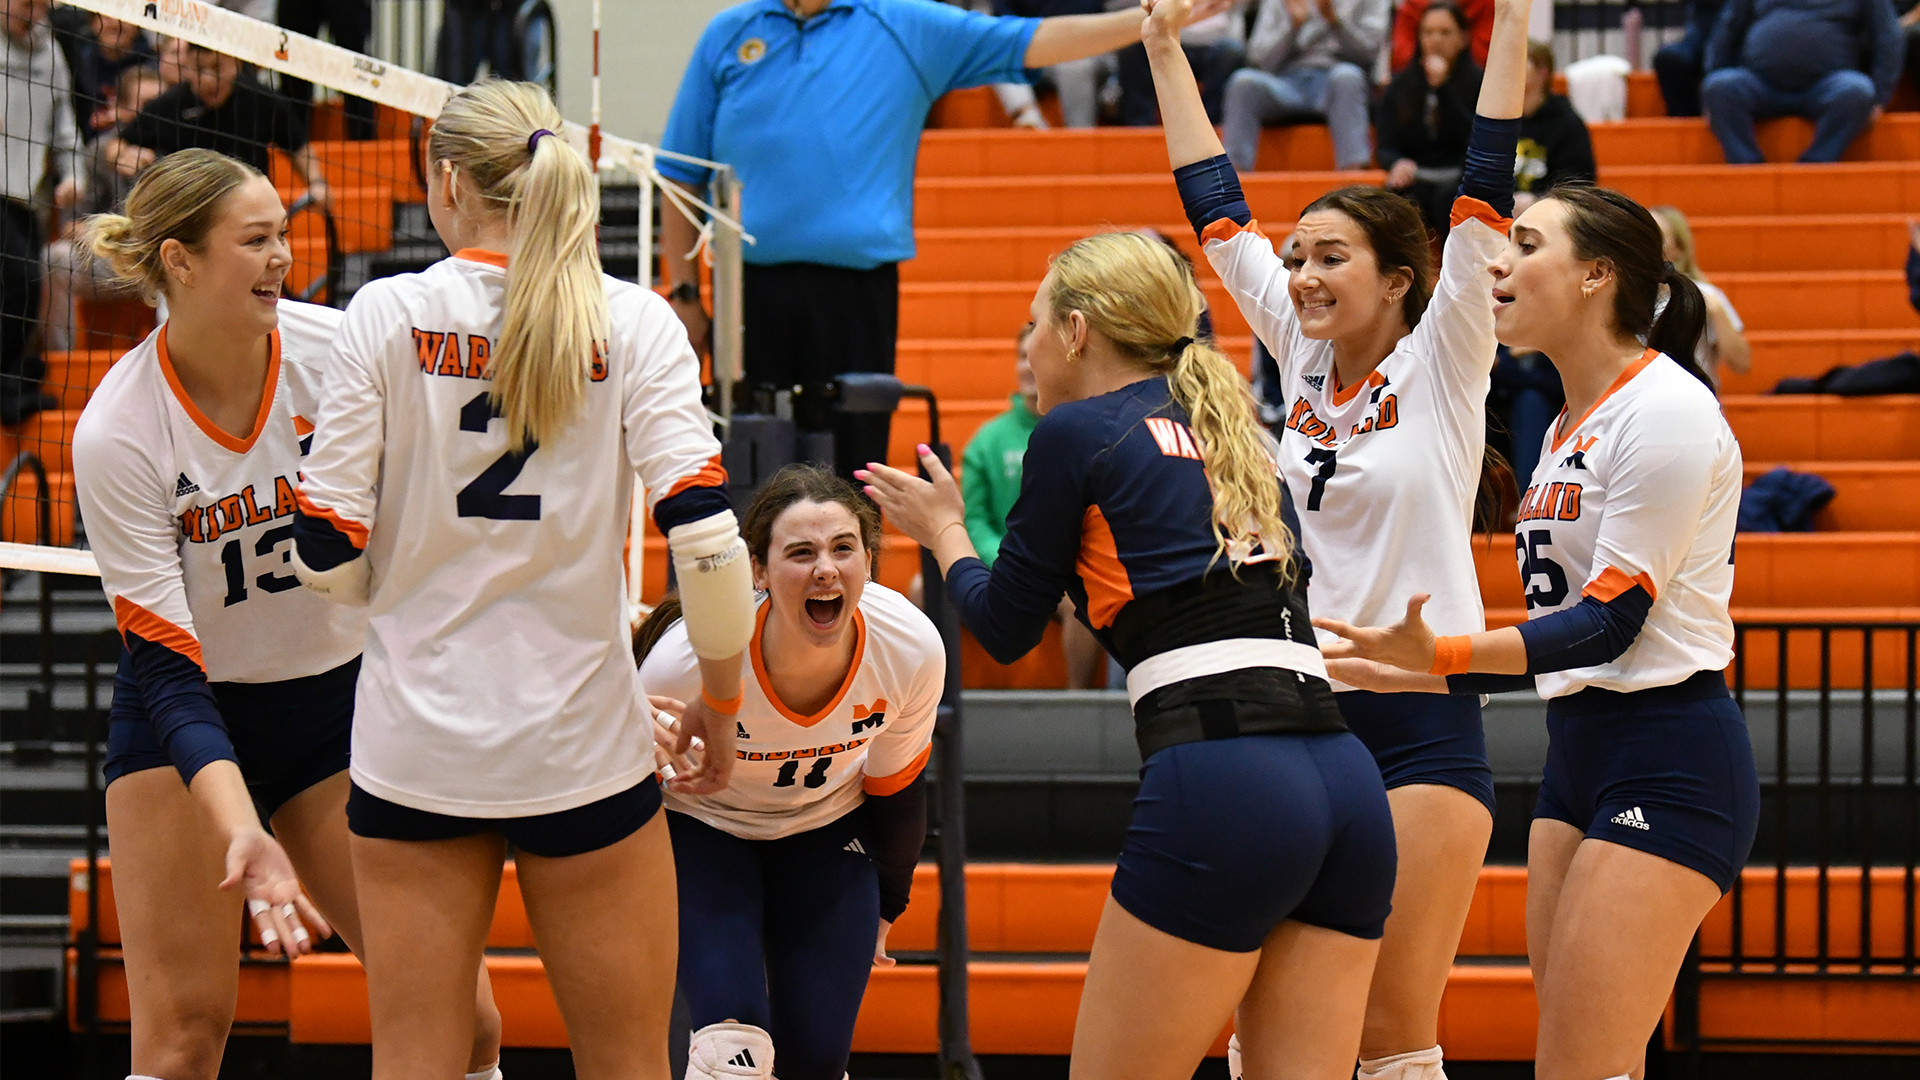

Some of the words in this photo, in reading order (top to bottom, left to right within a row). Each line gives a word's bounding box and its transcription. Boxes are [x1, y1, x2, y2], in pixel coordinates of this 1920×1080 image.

[457, 391, 542, 521] 2
[1303, 447, 1338, 512] 7
[221, 523, 303, 608] 13
[1515, 529, 1570, 611] 25
[772, 756, 833, 789] 11
[1610, 816, 1650, 831] adidas
